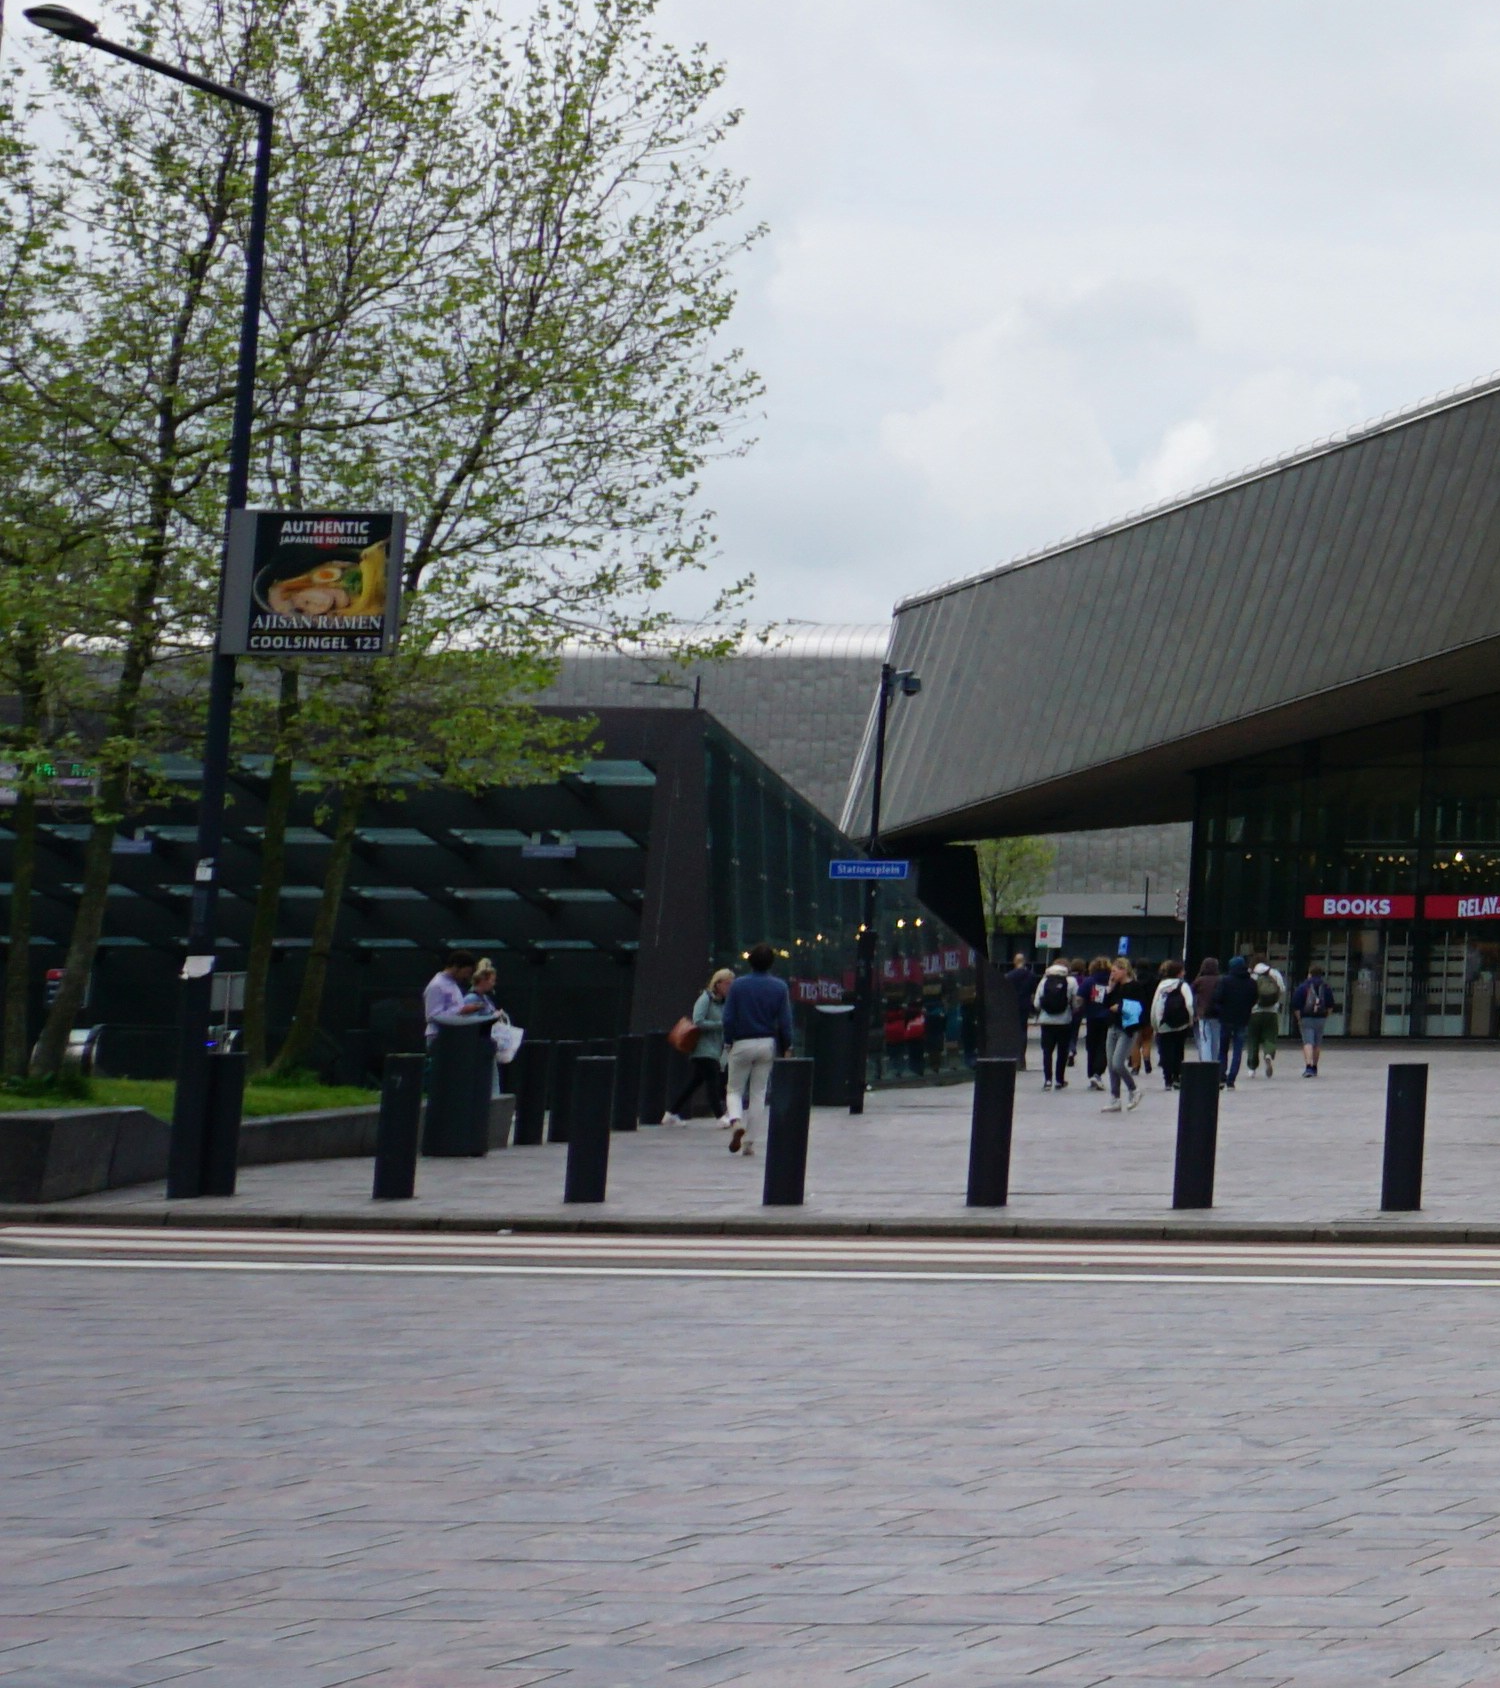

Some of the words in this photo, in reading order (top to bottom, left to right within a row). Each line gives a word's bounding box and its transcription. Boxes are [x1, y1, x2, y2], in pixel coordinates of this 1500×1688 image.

[280, 520, 370, 534] AUTHENTIC
[279, 535, 324, 545] JAPANESE
[325, 535, 369, 545] NOODLES
[252, 614, 312, 631] AJISAN
[317, 614, 382, 630] RAMEN
[250, 635, 348, 650] COOLSINGEL
[354, 636, 380, 650] 123
[837, 863, 900, 877] Stationsplein
[1322, 898, 1391, 916] BOOKS
